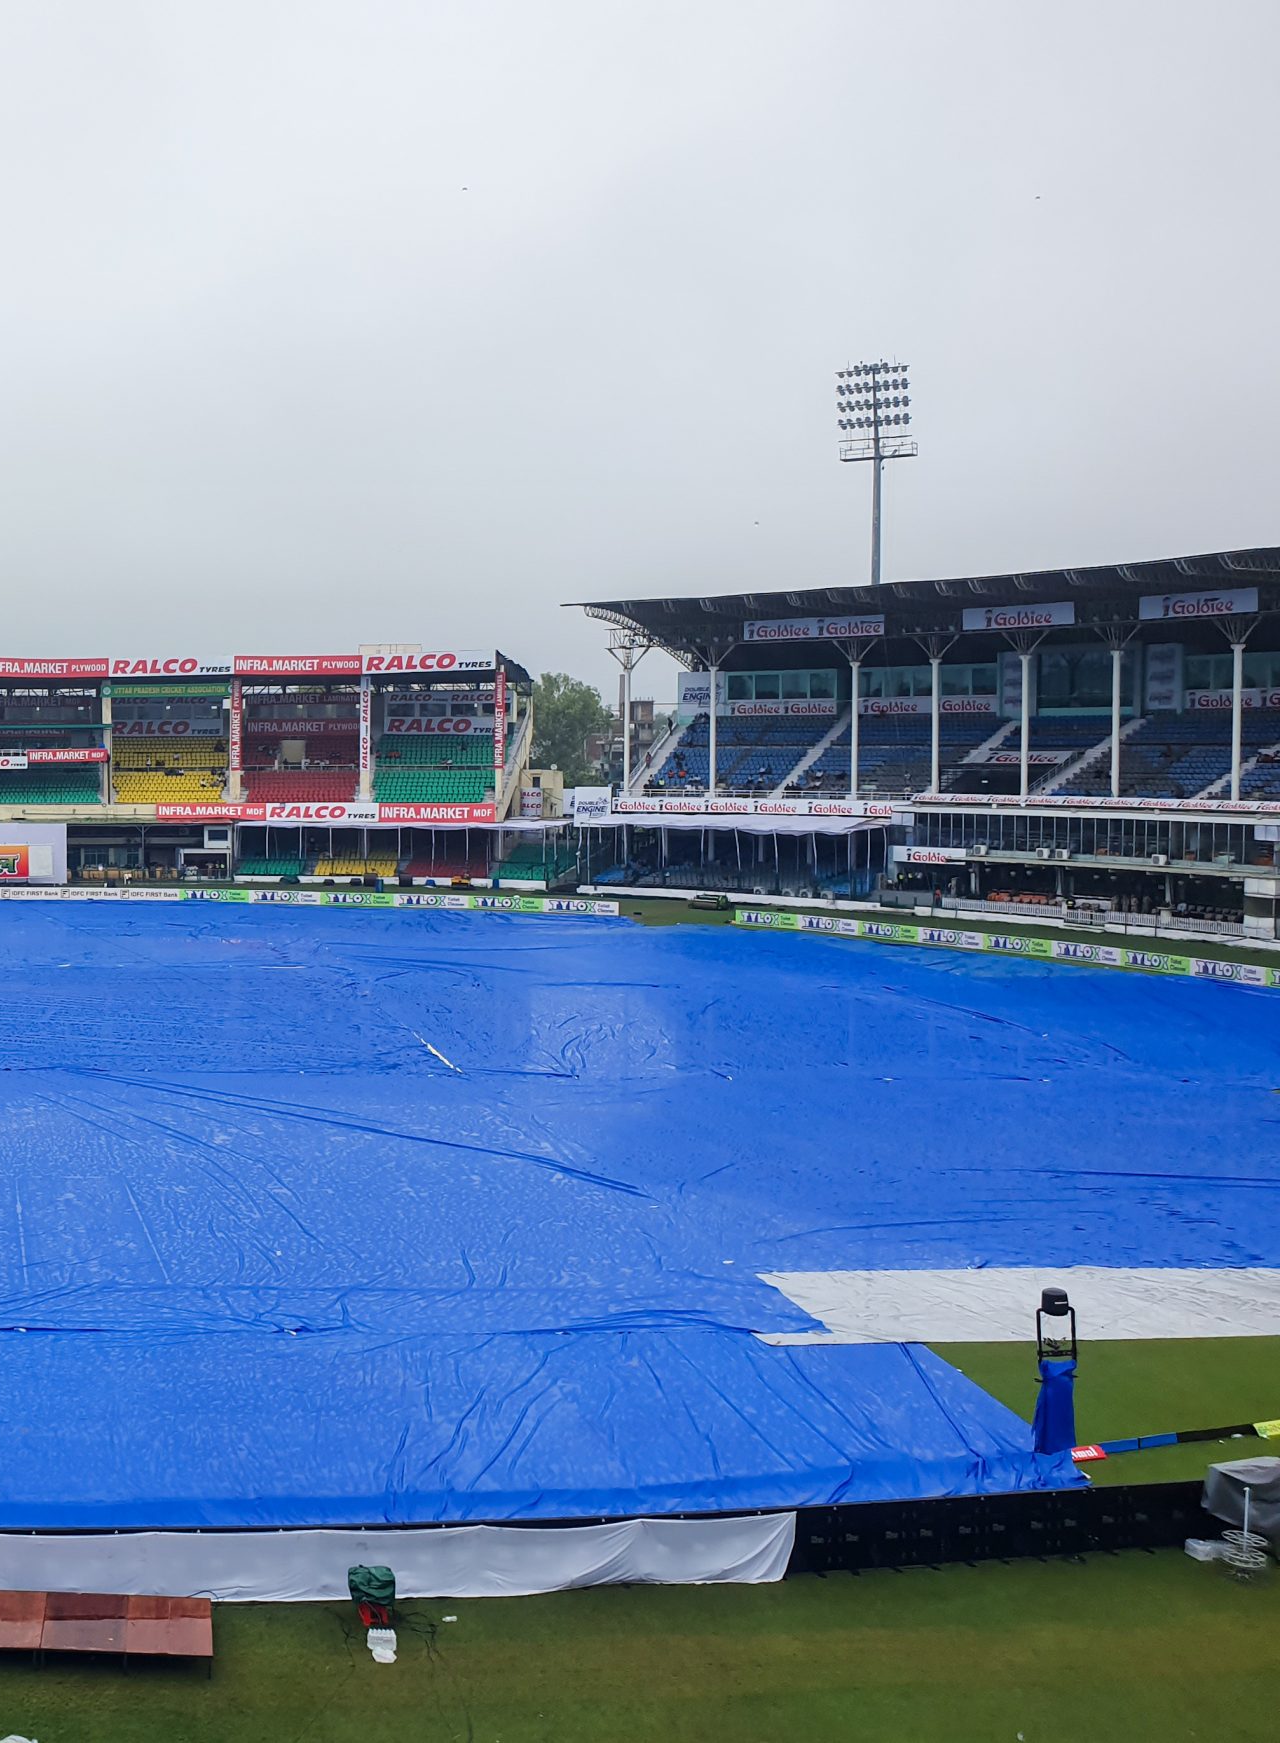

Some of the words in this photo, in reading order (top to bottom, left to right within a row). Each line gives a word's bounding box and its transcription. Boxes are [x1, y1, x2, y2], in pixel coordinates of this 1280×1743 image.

[71, 663, 106, 672] PLYWOOD
[112, 658, 198, 674] RALCO
[236, 660, 319, 672] INFRA.MARKET
[322, 660, 360, 670] PLYWOOD
[366, 654, 456, 671] RALCO
[112, 721, 190, 734] RALCO
[248, 722, 325, 732] INFRA.MARKET
[388, 718, 472, 732] RALCO
[231, 708, 240, 768] INFRA.MARKET
[495, 708, 503, 766] INFRA.MARKET
[30, 751, 90, 760] INFRA.MARKET
[158, 806, 242, 816] INFRA.MARKET
[246, 808, 264, 816] MDF
[270, 806, 346, 818] RALCO
[381, 807, 470, 819] INFRA.MARKET
[473, 808, 492, 816] MDF
[184, 890, 228, 900] TYLOX
[254, 891, 299, 902] TYLOX
[327, 893, 372, 904] TYLOX
[400, 895, 446, 907] TYLOX
[474, 896, 520, 909] TYLOX
[549, 900, 596, 913] TYLOX
[741, 912, 779, 926] TYLOX
[803, 917, 840, 932] TYLOX
[864, 923, 900, 938] TYLOX
[923, 929, 964, 945] TYLOX
[989, 936, 1030, 952] TYLOX
[1058, 942, 1100, 960] TYLOX
[1126, 951, 1169, 970] TYLOX
[1196, 960, 1244, 980] TYLOX
